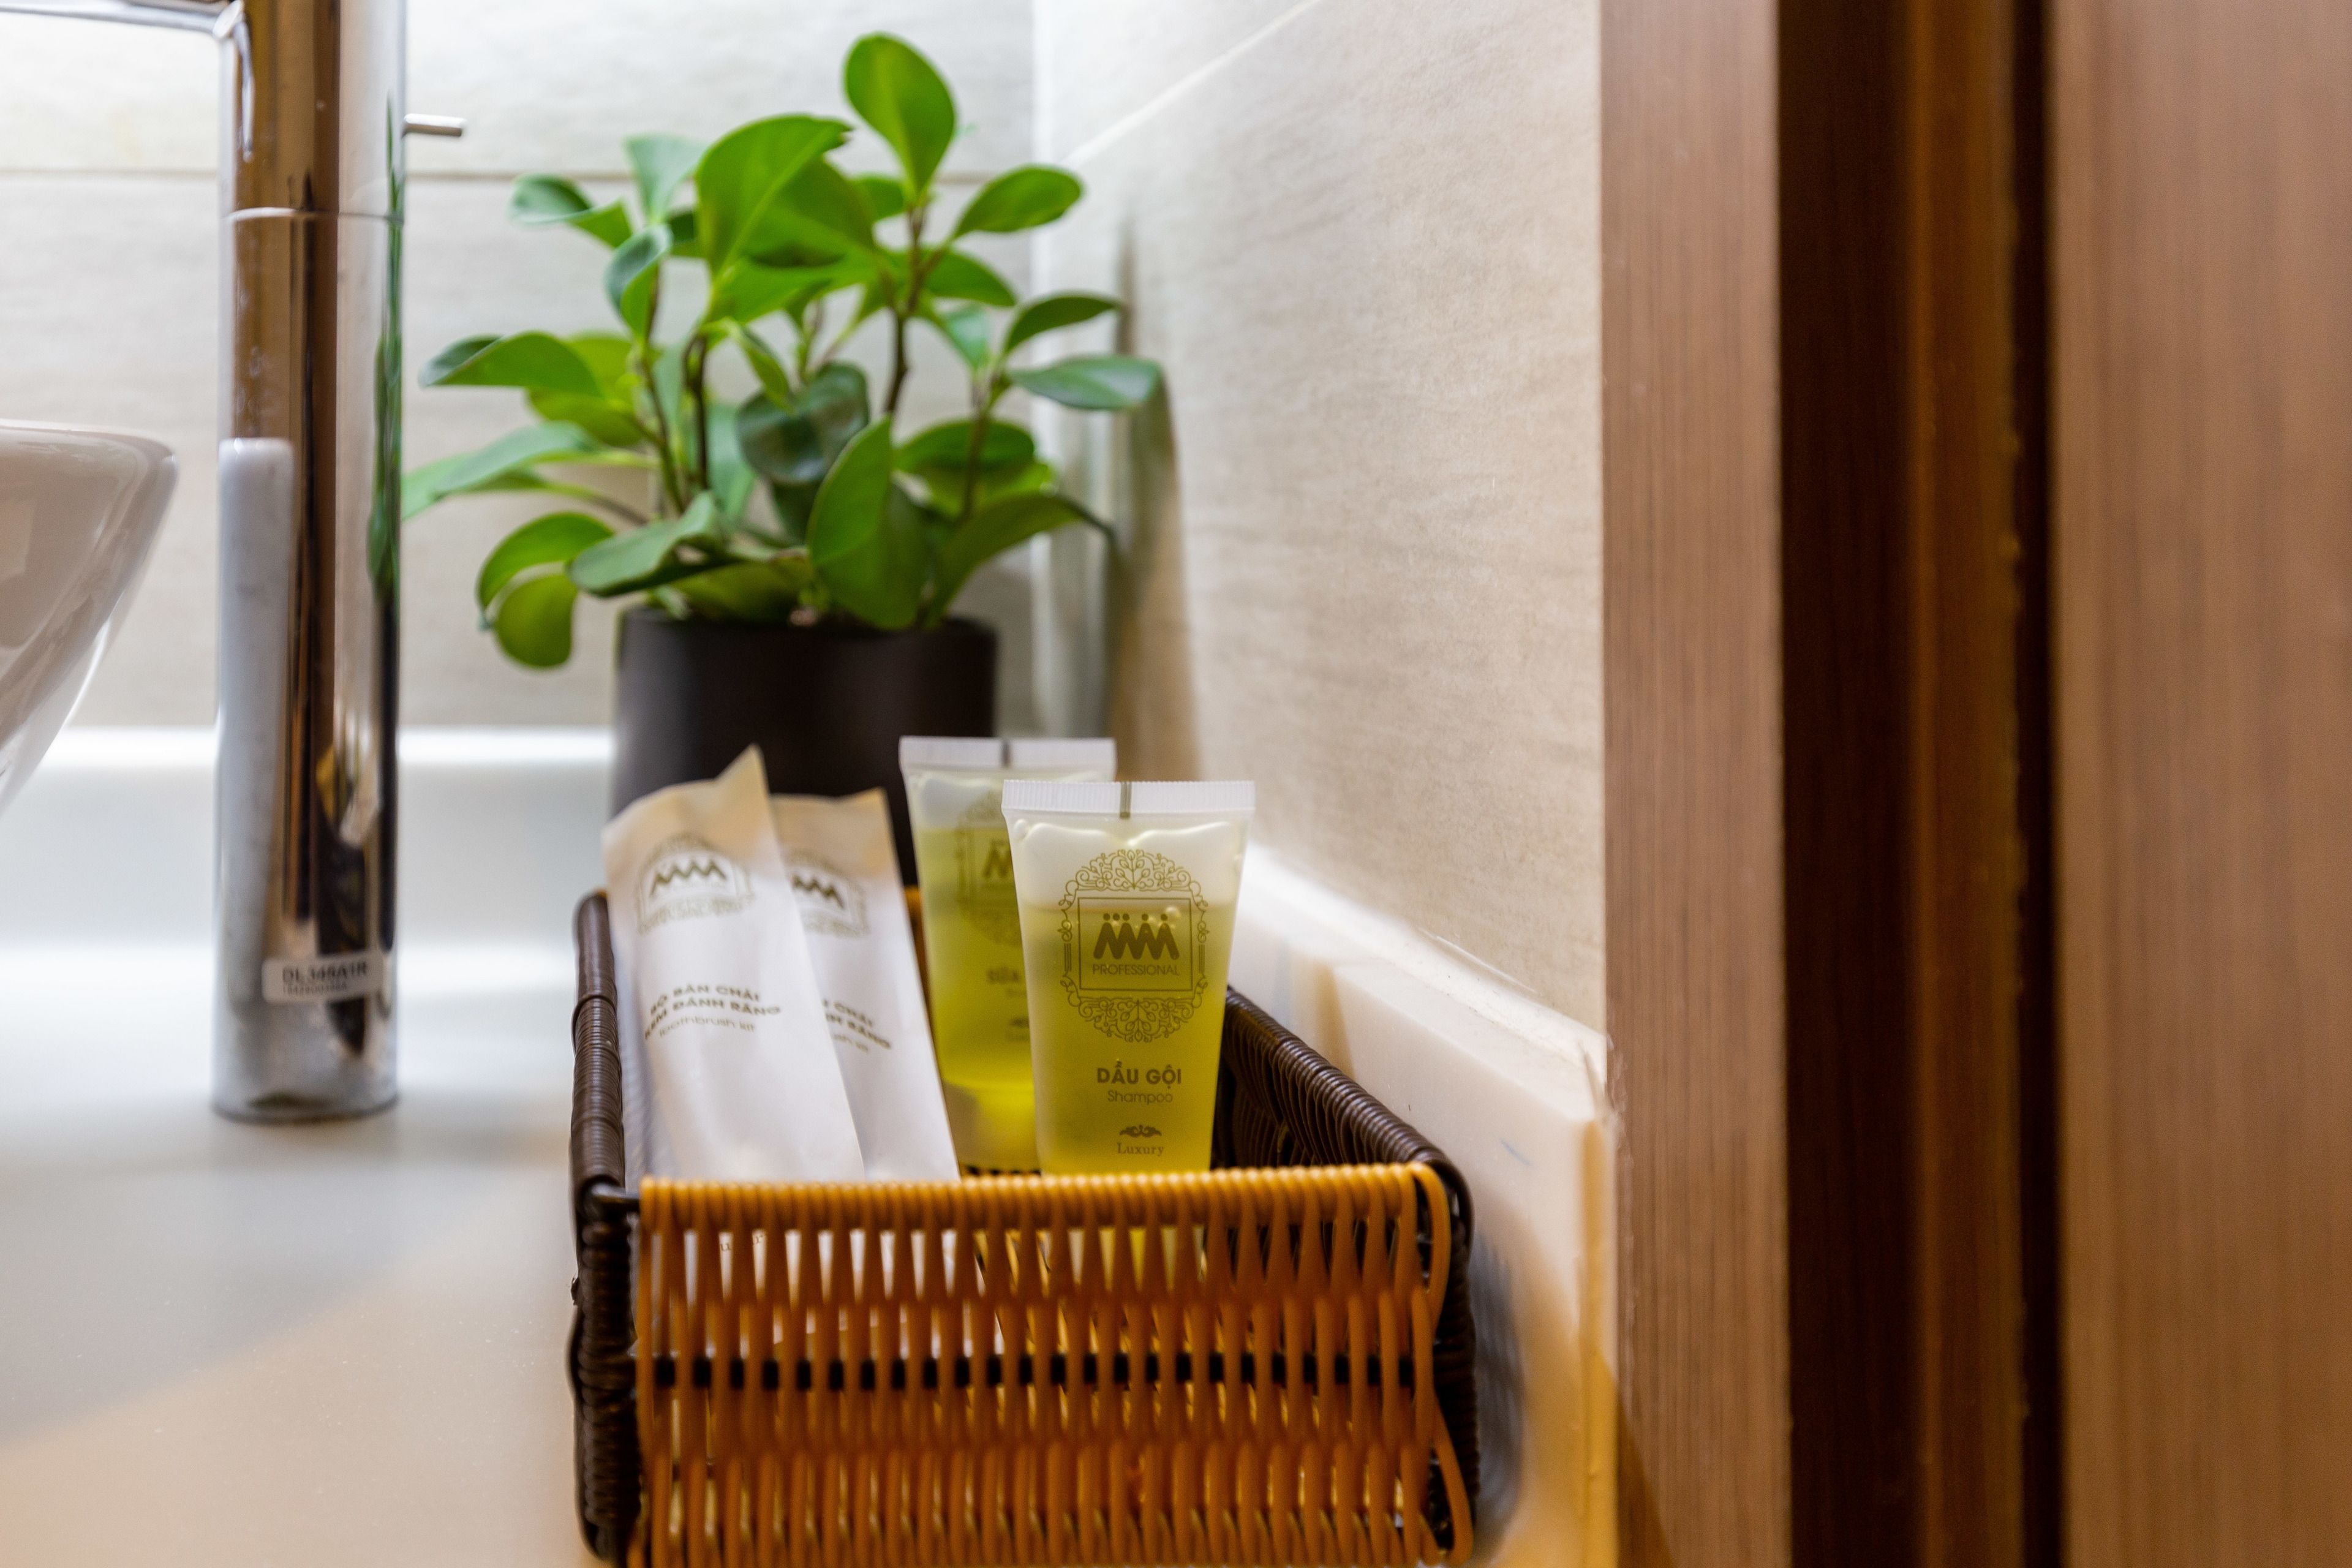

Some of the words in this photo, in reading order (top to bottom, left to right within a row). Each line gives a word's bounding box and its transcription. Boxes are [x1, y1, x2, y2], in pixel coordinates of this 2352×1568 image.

[1093, 963, 1180, 976] PROFESSIONAL
[1097, 1060, 1139, 1085] DẦU
[1146, 1064, 1182, 1089] GỘI
[1107, 1090, 1173, 1105] Shampoo
[1117, 1142, 1164, 1156] Luxury
